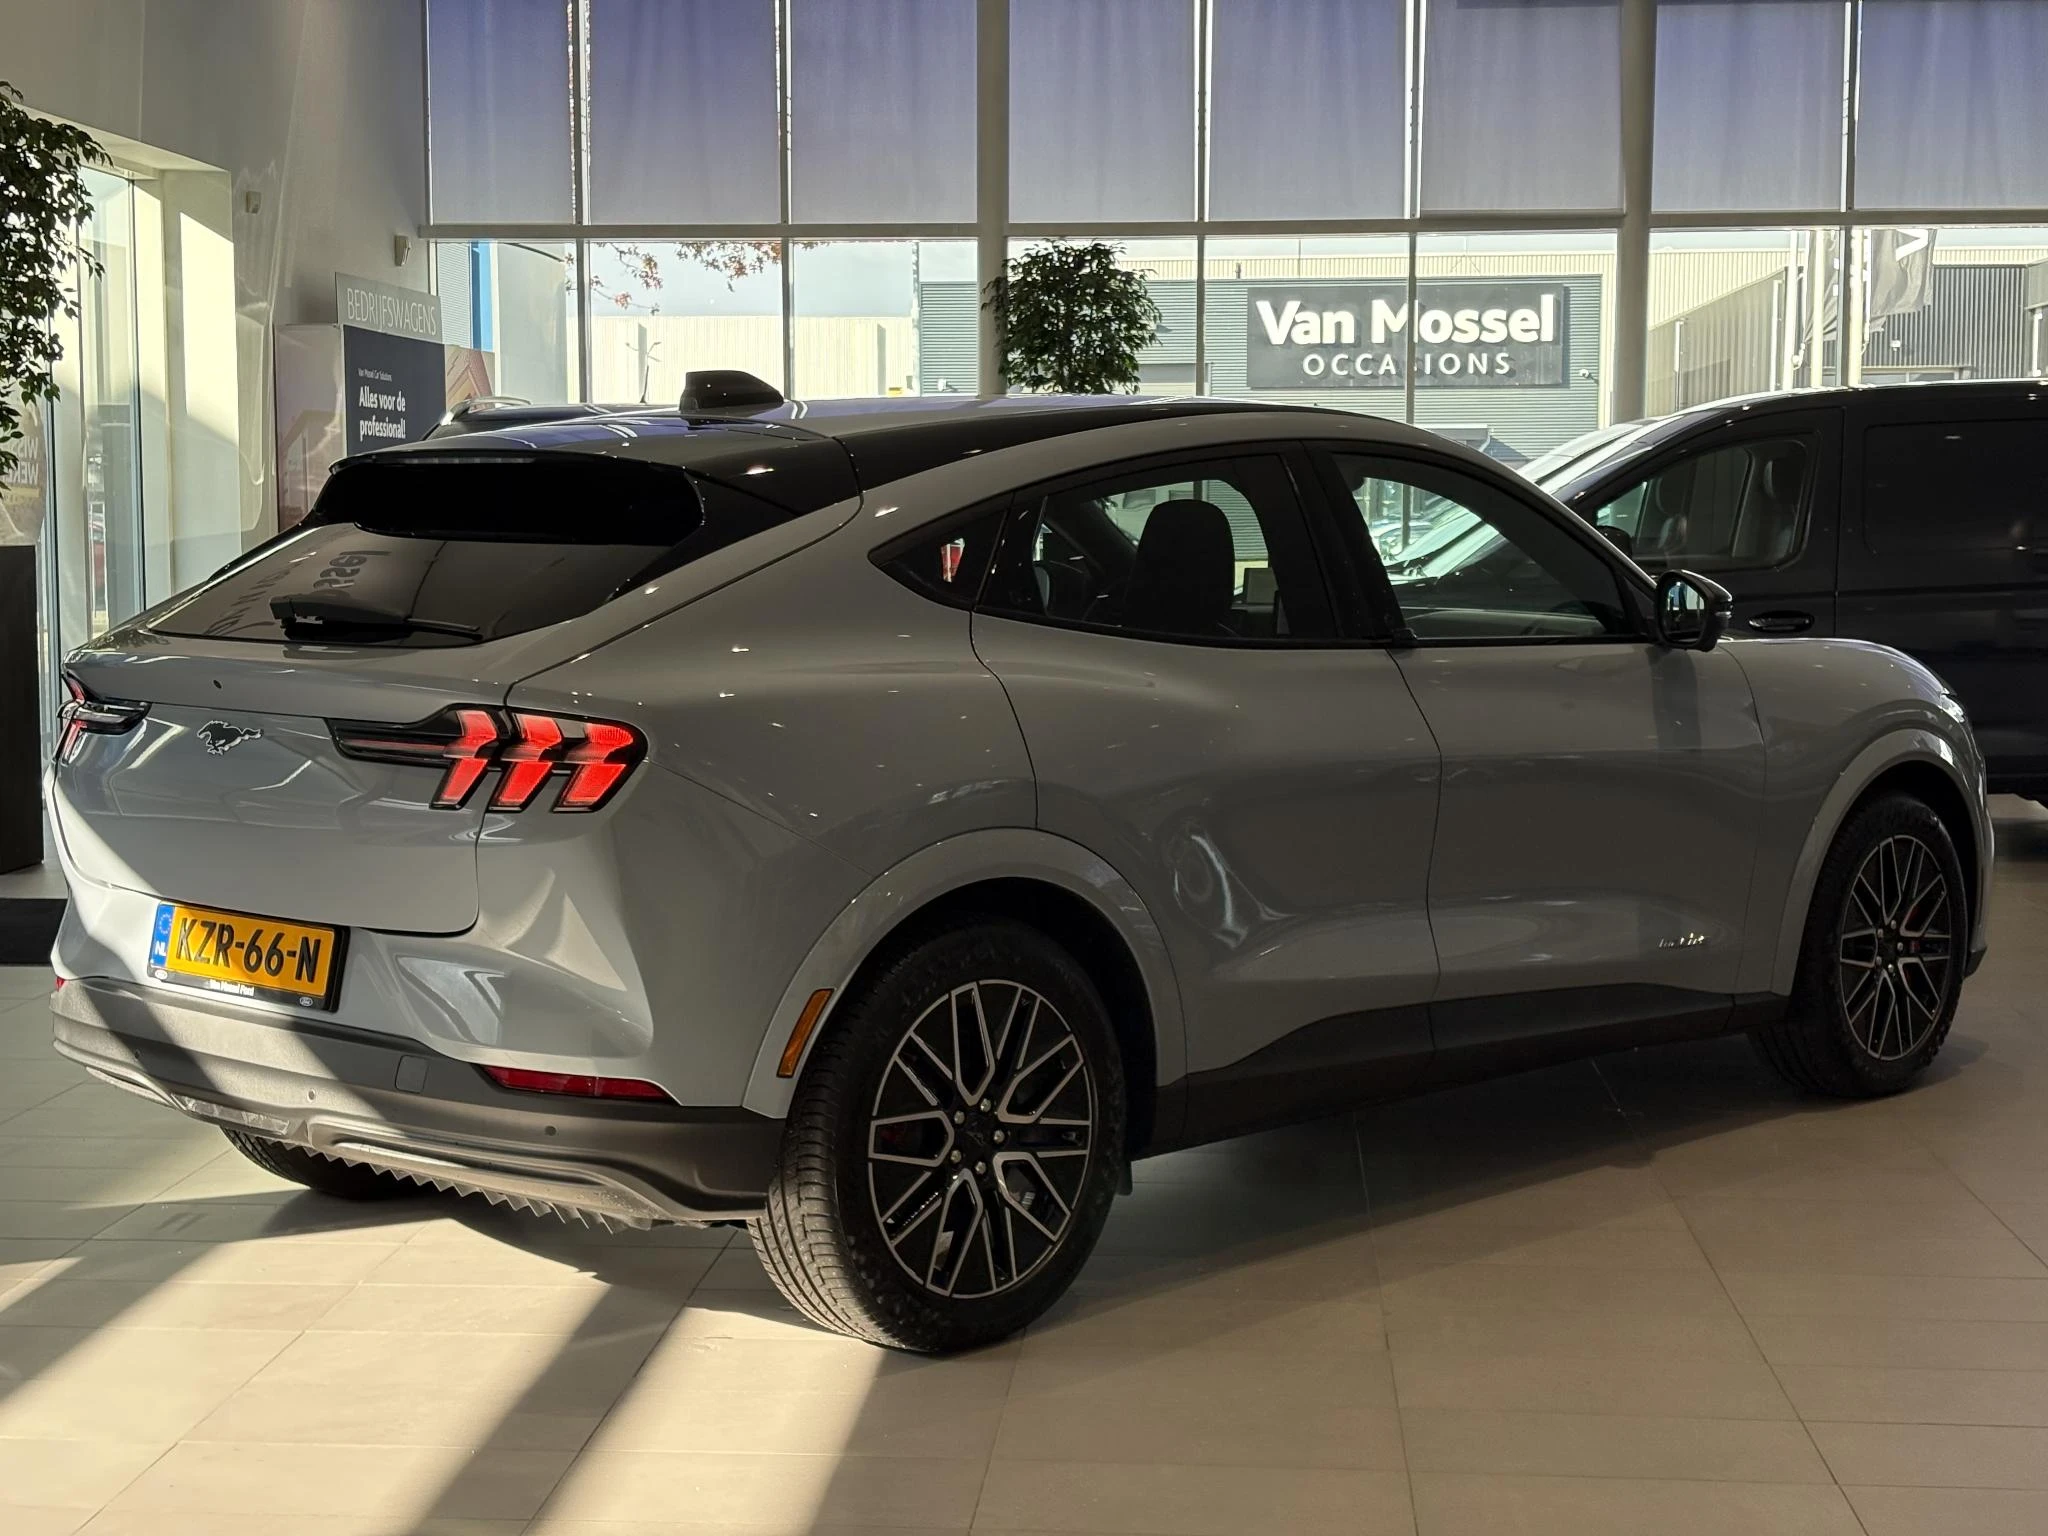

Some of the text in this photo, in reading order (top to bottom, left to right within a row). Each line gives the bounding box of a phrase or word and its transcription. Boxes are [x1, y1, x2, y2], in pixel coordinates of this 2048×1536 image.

[346, 287, 437, 336] BEDRIJFSWAGENS
[1255, 294, 1554, 345] Van Mossel
[1302, 352, 1511, 376] OCCAIONS
[359, 385, 406, 412] Alles voor de
[359, 414, 406, 442] professional!
[154, 940, 167, 957] NL
[175, 917, 321, 983] KZR-66-N
